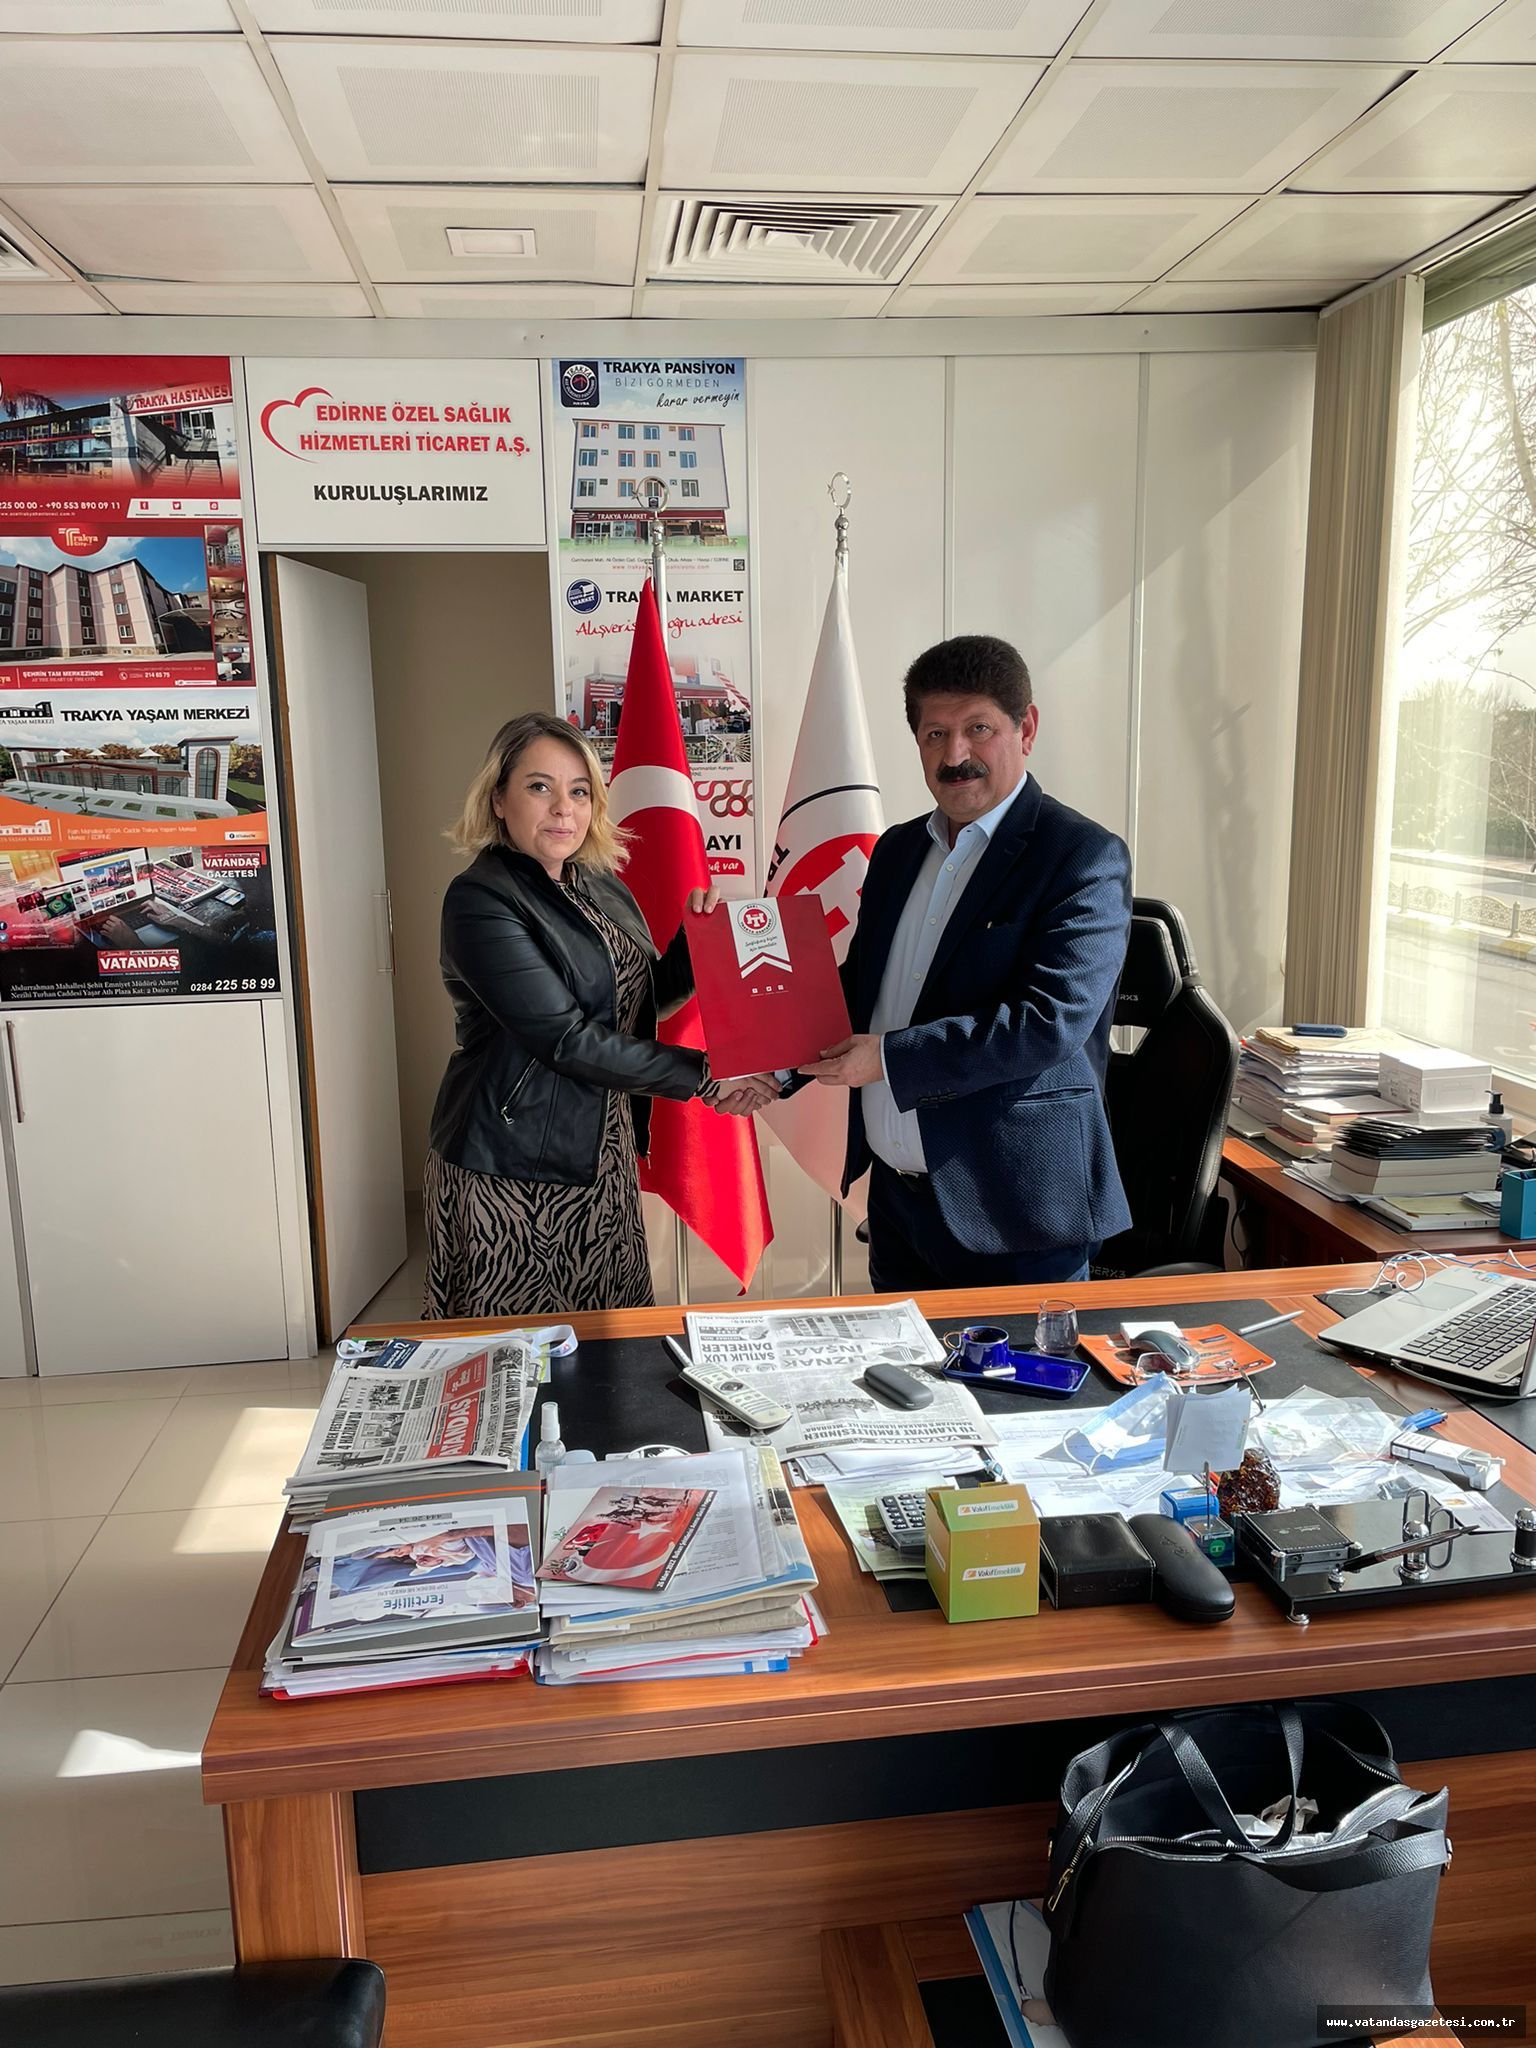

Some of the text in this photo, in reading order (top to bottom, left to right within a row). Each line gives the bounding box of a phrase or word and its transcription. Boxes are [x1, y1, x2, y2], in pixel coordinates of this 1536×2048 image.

[603, 360, 735, 374] TRAKYA PANSİYON
[615, 377, 720, 387] BİZİ GÖRMEDEN
[134, 394, 169, 409] TRAKYA
[657, 388, 739, 407] karar vermeyin
[316, 401, 511, 424] EDİRNE ÖZEL SAĞLIK
[300, 431, 530, 456] HİZMETLERİ TİCARET A.Ş.
[313, 485, 488, 505] KURULUŞLARIMIZ
[14, 502, 25, 510] 00
[27, 502, 37, 510] 00
[58, 528, 98, 546] Trakya
[676, 590, 744, 602] MARKET
[668, 617, 696, 638] oğru
[698, 610, 744, 626] adresi
[23, 670, 45, 679] ŞEHRİN
[63, 669, 104, 677] MERKEZİNDE
[60, 705, 250, 723] TRAKYA YAŞAM MERKEZİ
[706, 835, 741, 850] AYI
[204, 858, 260, 868] VATANDAŞ
[722, 862, 739, 870] var
[207, 869, 257, 878] GAZETESİ
[99, 955, 179, 970] VATANDAŞ
[55, 982, 86, 990] Mahallesi
[87, 981, 103, 990] Şehit
[190, 978, 275, 992] 0284 225 58 99
[11, 991, 32, 999] Nezihi
[83, 989, 101, 998] Yaşar
[1120, 994, 1139, 1002] RX3
[1089, 1264, 1126, 1278] DERX3
[702, 1342, 772, 1353] DAİRELER
[783, 1344, 863, 1357] İNŞAAT
[727, 1351, 775, 1361] SATILIK
[338, 1411, 363, 1444] HAZİRAN'DA
[439, 1397, 478, 1457] ATANDAŞ
[903, 1426, 957, 1436] İLAHİYAT
[321, 1432, 338, 1450] KÜREK
[803, 1428, 900, 1441] FAKÜLTESİNDEN
